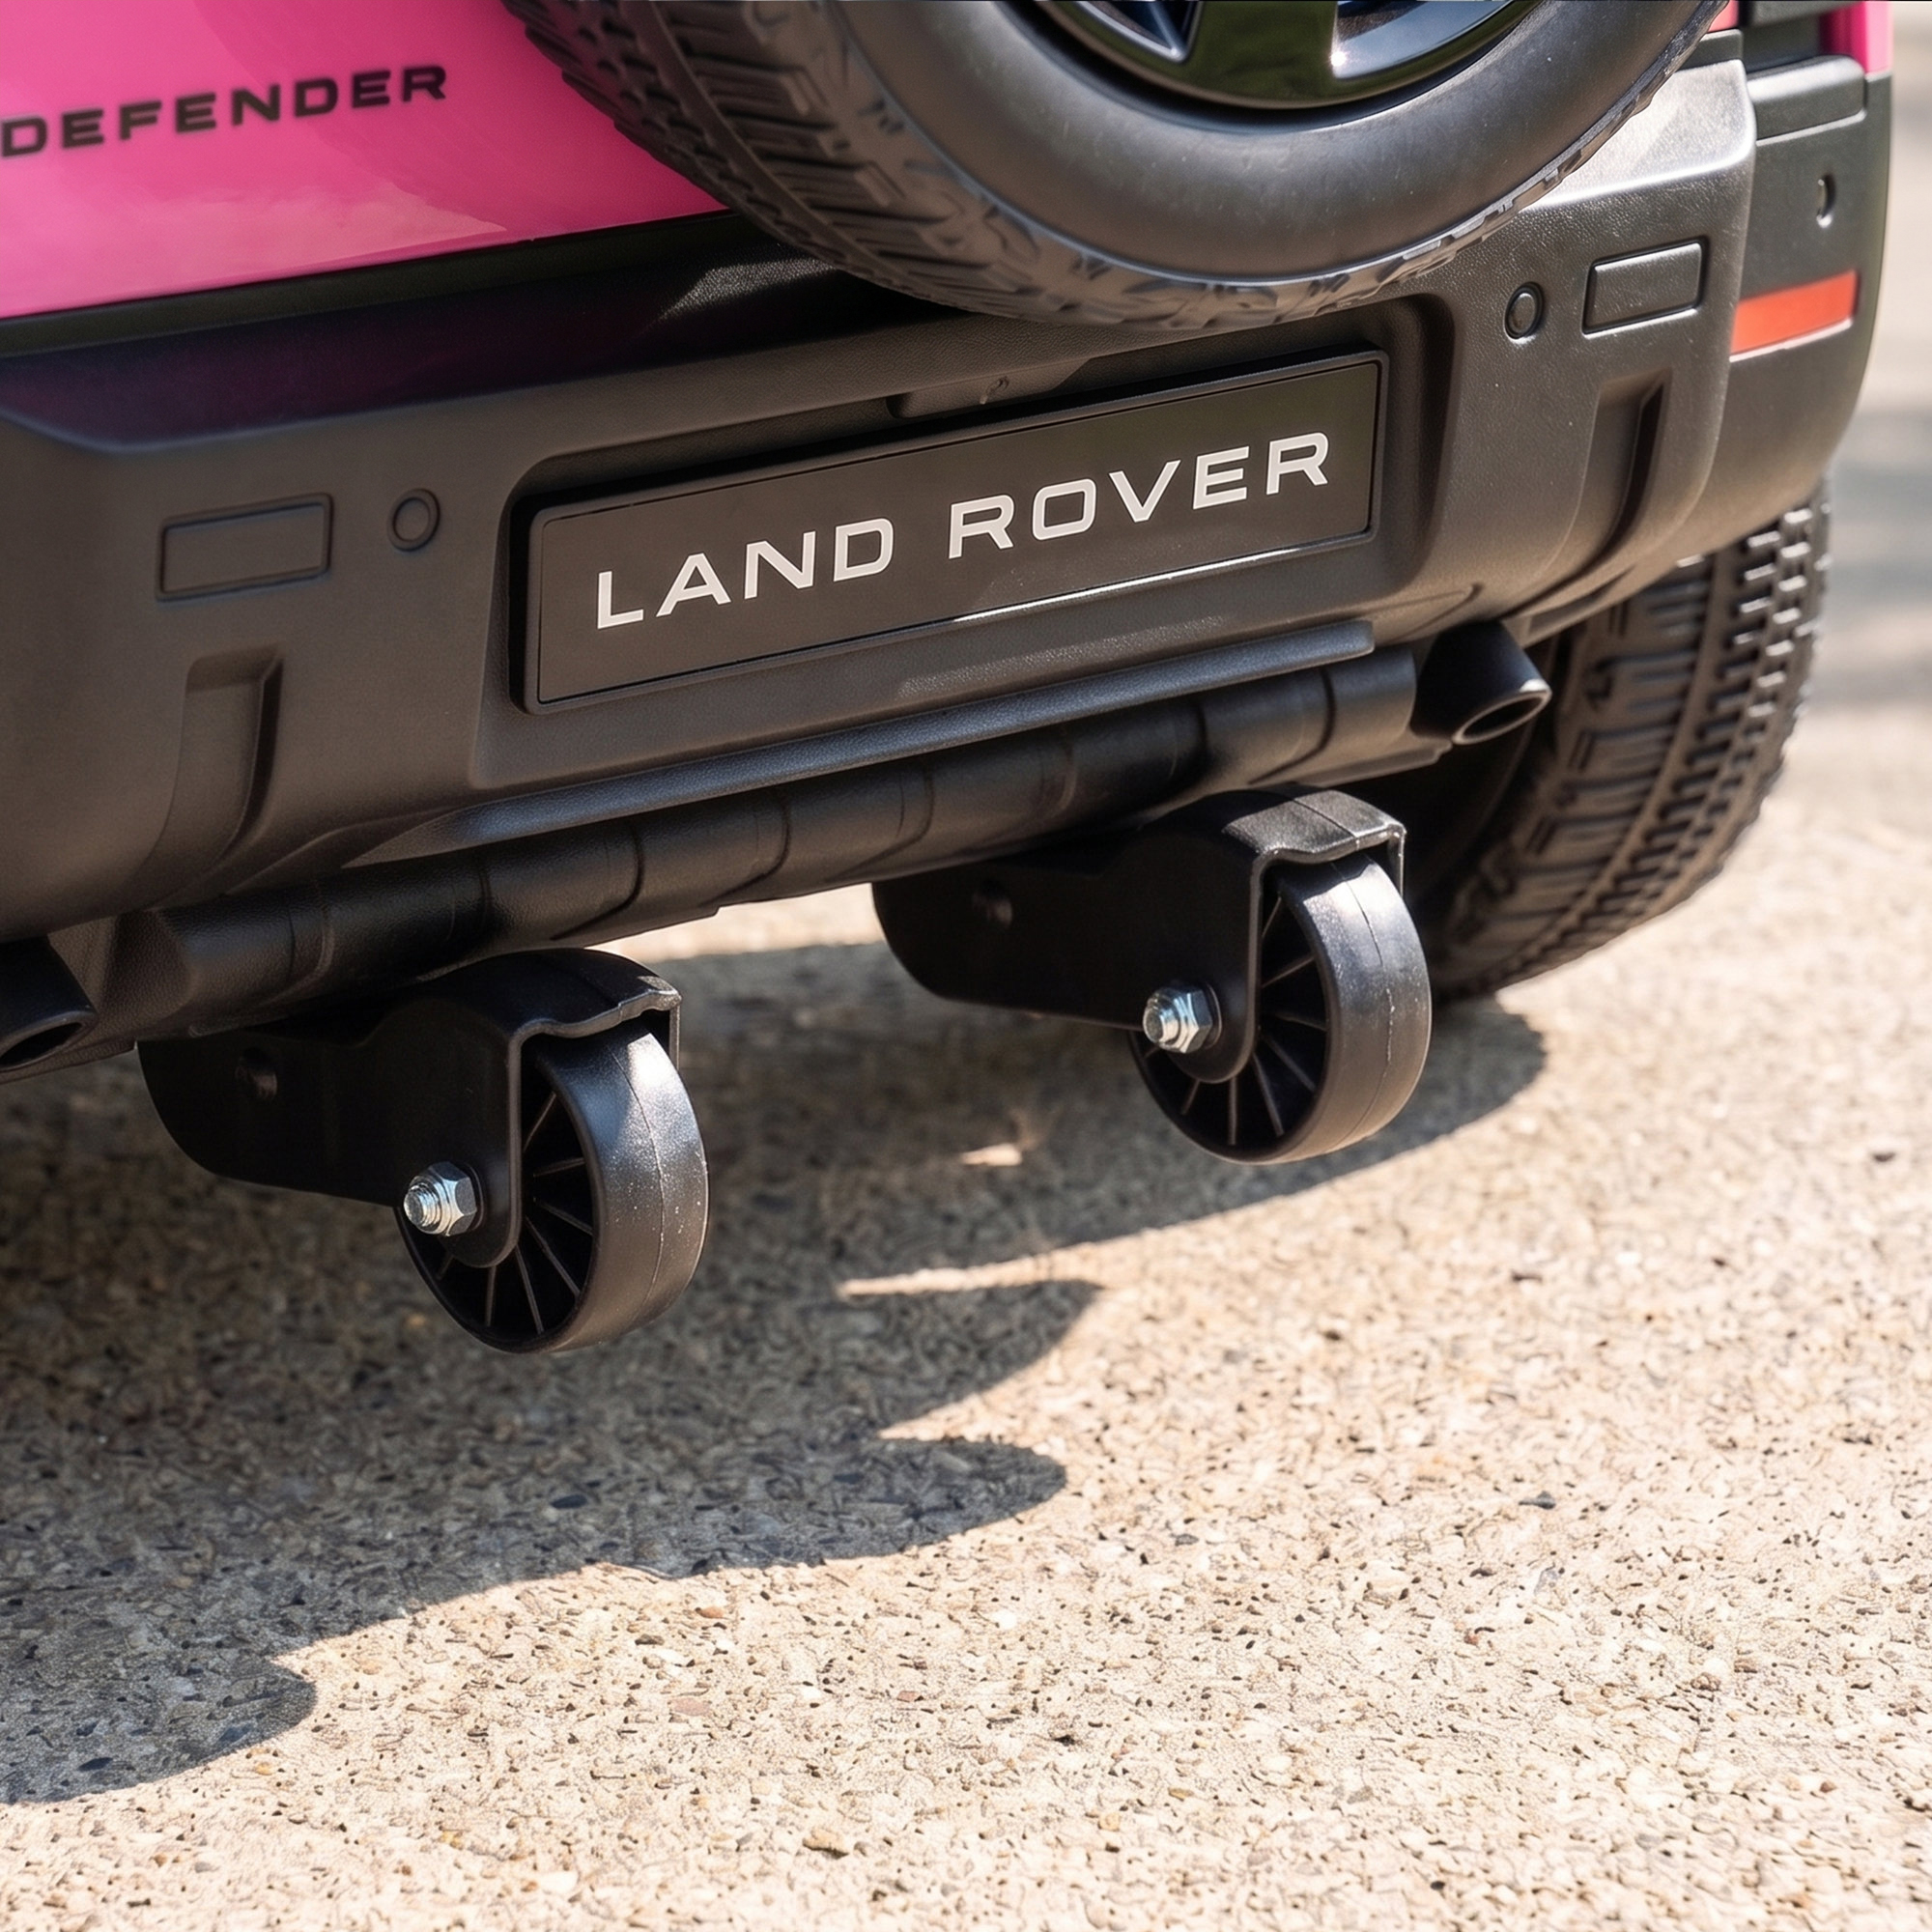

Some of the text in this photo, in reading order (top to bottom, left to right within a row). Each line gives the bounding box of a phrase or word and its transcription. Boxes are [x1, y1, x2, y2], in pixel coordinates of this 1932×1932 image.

[0, 65, 447, 157] DEFENDER
[596, 431, 1330, 630] LAND ROVER
